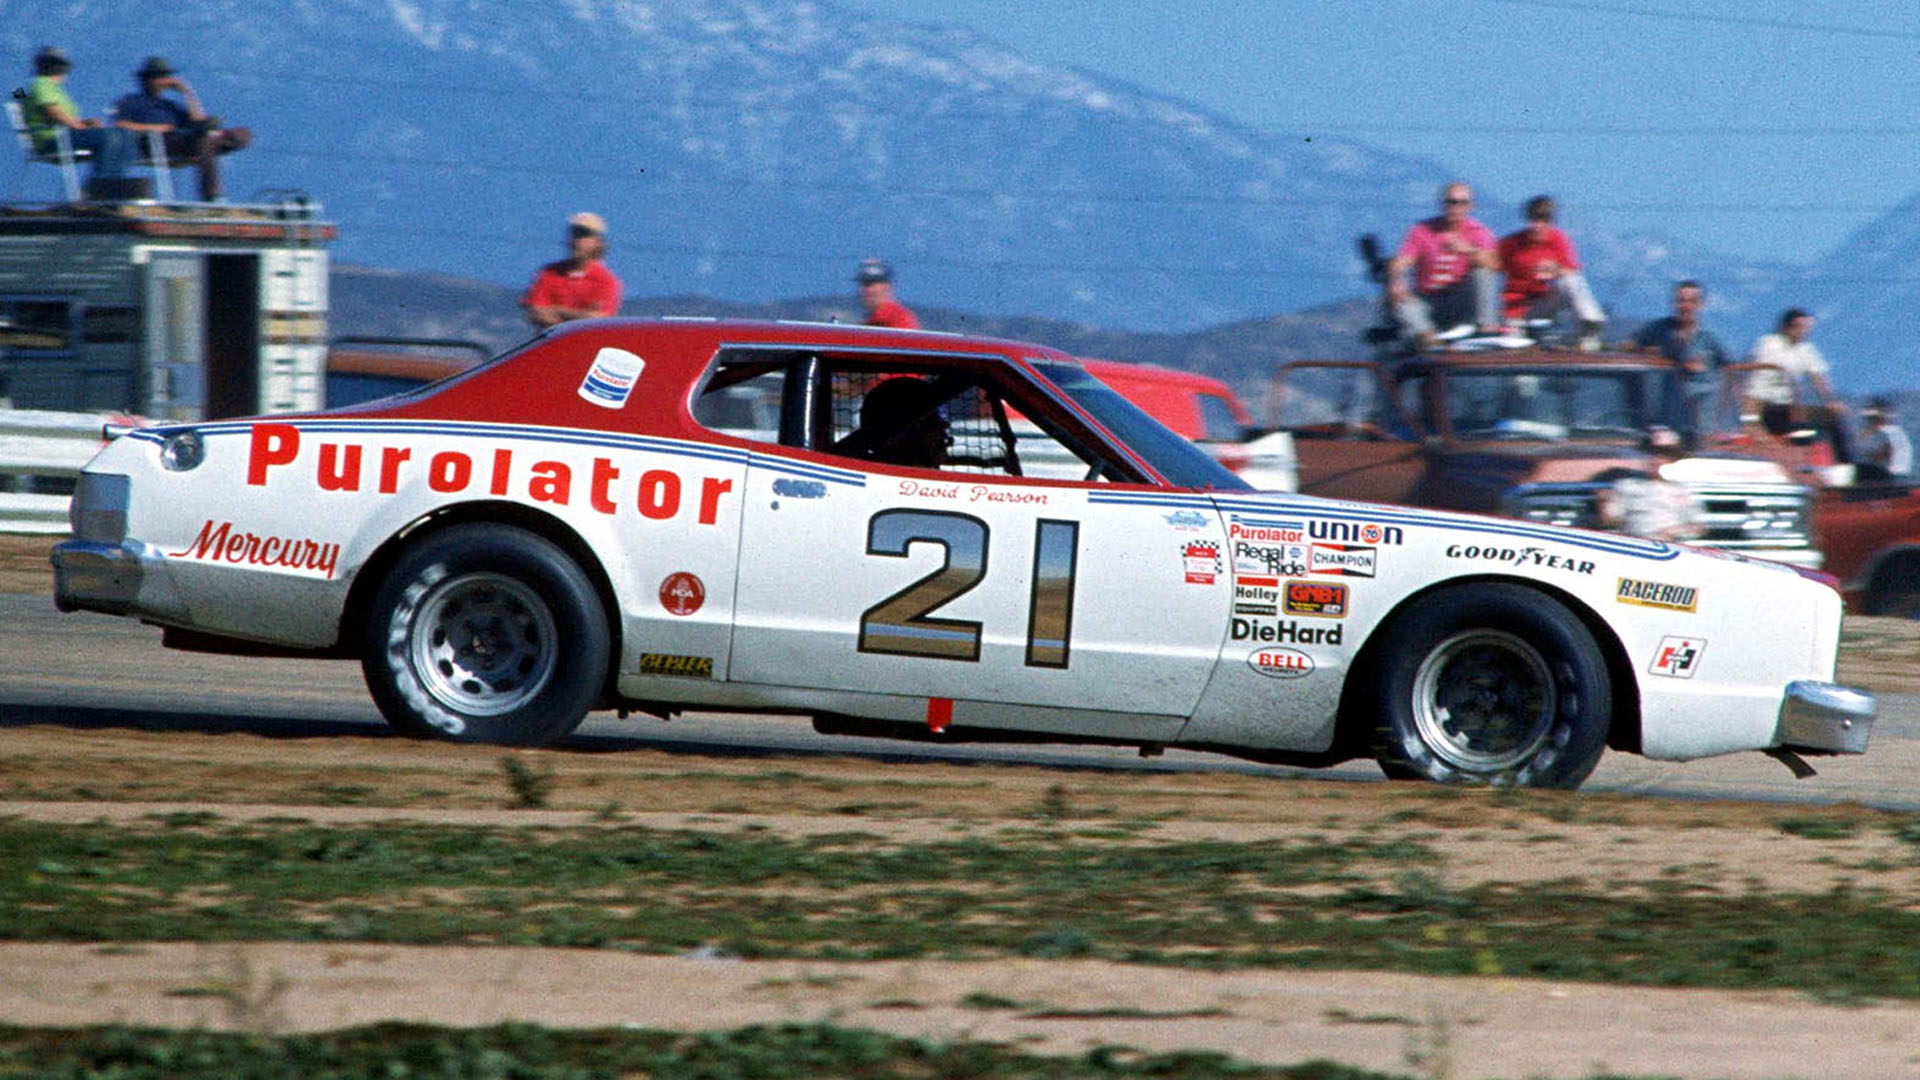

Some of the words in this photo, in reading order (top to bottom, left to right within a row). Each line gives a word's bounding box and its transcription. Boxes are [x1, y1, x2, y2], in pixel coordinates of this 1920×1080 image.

[246, 423, 734, 526] Purolator
[899, 480, 960, 500] David
[969, 485, 1049, 505] Pearson
[1229, 524, 1304, 543] Purolator
[168, 519, 342, 580] Mercury
[1236, 542, 1285, 563] Regal
[1313, 552, 1373, 568] CHAMPION
[1268, 559, 1307, 577] Ride
[857, 507, 1080, 670] 21
[1235, 586, 1279, 603] Holley
[1618, 578, 1697, 606] RACEROD
[1231, 618, 1344, 646] DieHard
[1258, 653, 1308, 671] BELL
